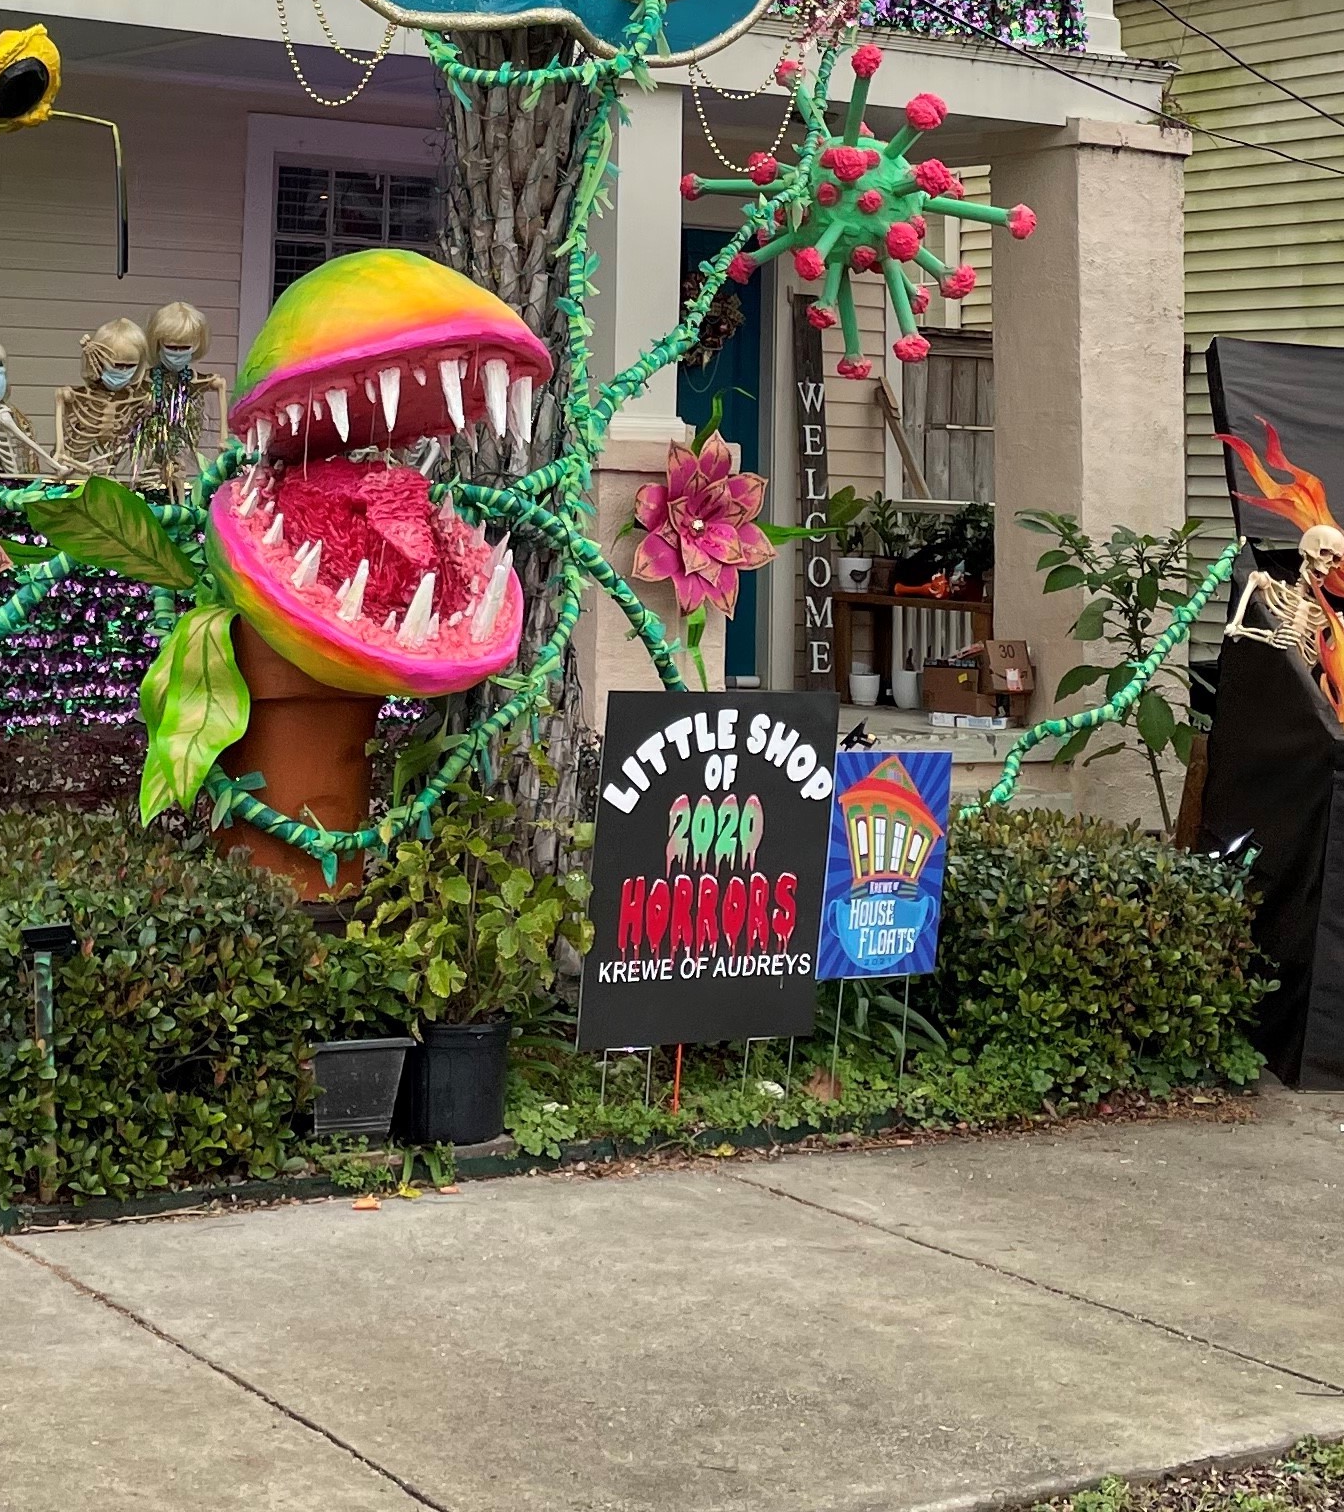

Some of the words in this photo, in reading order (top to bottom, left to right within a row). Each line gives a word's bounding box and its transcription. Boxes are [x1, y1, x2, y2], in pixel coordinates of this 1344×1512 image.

[798, 381, 834, 674] WELCOME
[998, 644, 1016, 659] 30
[602, 709, 739, 814] LITTLE
[746, 713, 834, 800] SHOP
[704, 754, 738, 791] OF
[666, 793, 765, 875] 2020
[618, 872, 798, 958] HORRORS
[848, 898, 896, 930] HOUSE
[857, 927, 916, 959] FLOATS
[598, 959, 674, 983] KREWE
[680, 957, 708, 981] OF
[713, 953, 812, 978] AUDREYS
